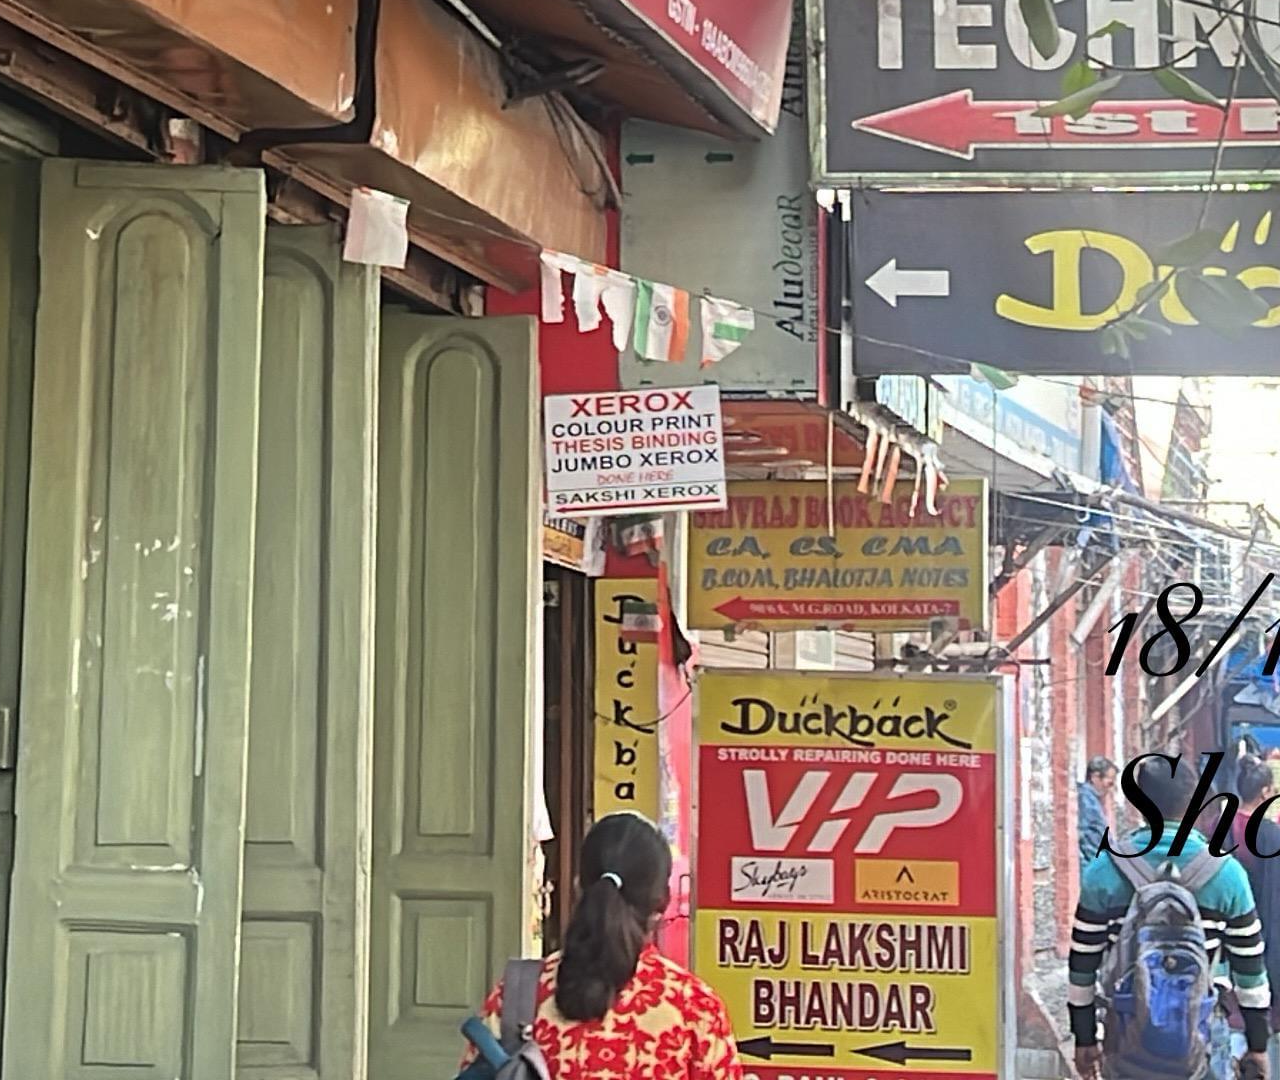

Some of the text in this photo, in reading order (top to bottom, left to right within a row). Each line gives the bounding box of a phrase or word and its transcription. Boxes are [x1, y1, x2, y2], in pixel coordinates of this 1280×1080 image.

[571, 391, 693, 418] XEROX
[552, 413, 716, 438] COLOUR PRINT
[552, 431, 717, 455] THESIS BINDING
[552, 448, 719, 473] JUMBO XEROX
[596, 469, 674, 485] DONE HERE
[555, 484, 719, 505] SAKSHI XEROX
[862, 535, 966, 557] CMA
[899, 567, 969, 589] NOTES
[717, 747, 982, 768] STROLLY REPAIRING DONE HERE
[742, 769, 964, 854] VIP
[861, 889, 949, 902] ARISTOCRAT
[718, 917, 970, 974] RAJ LAKSHMI
[752, 978, 937, 1034] BHANDAR
